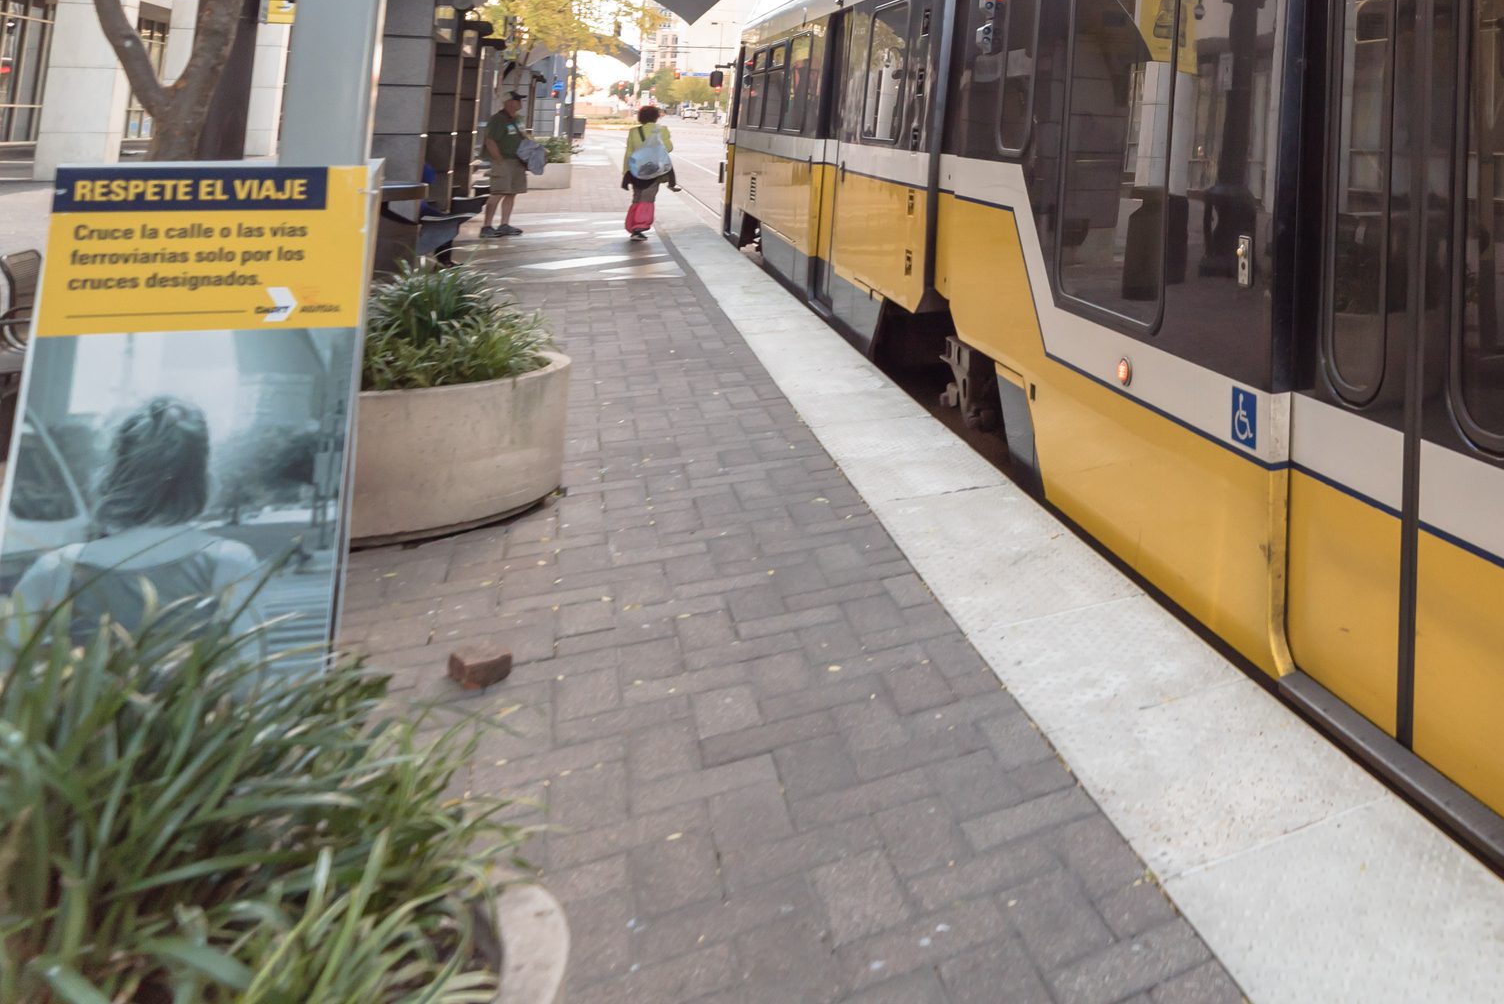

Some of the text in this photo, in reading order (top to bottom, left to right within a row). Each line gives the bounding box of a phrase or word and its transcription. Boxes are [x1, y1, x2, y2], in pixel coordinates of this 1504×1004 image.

[73, 179, 308, 202] RESPETE EL VIAJE
[73, 224, 135, 241] Cruce
[140, 223, 160, 240] la
[165, 222, 214, 239] calle
[219, 226, 232, 238] o
[236, 222, 266, 238] las
[69, 246, 306, 266] ferroviarias solo por los
[67, 271, 263, 291] cruces designados.
